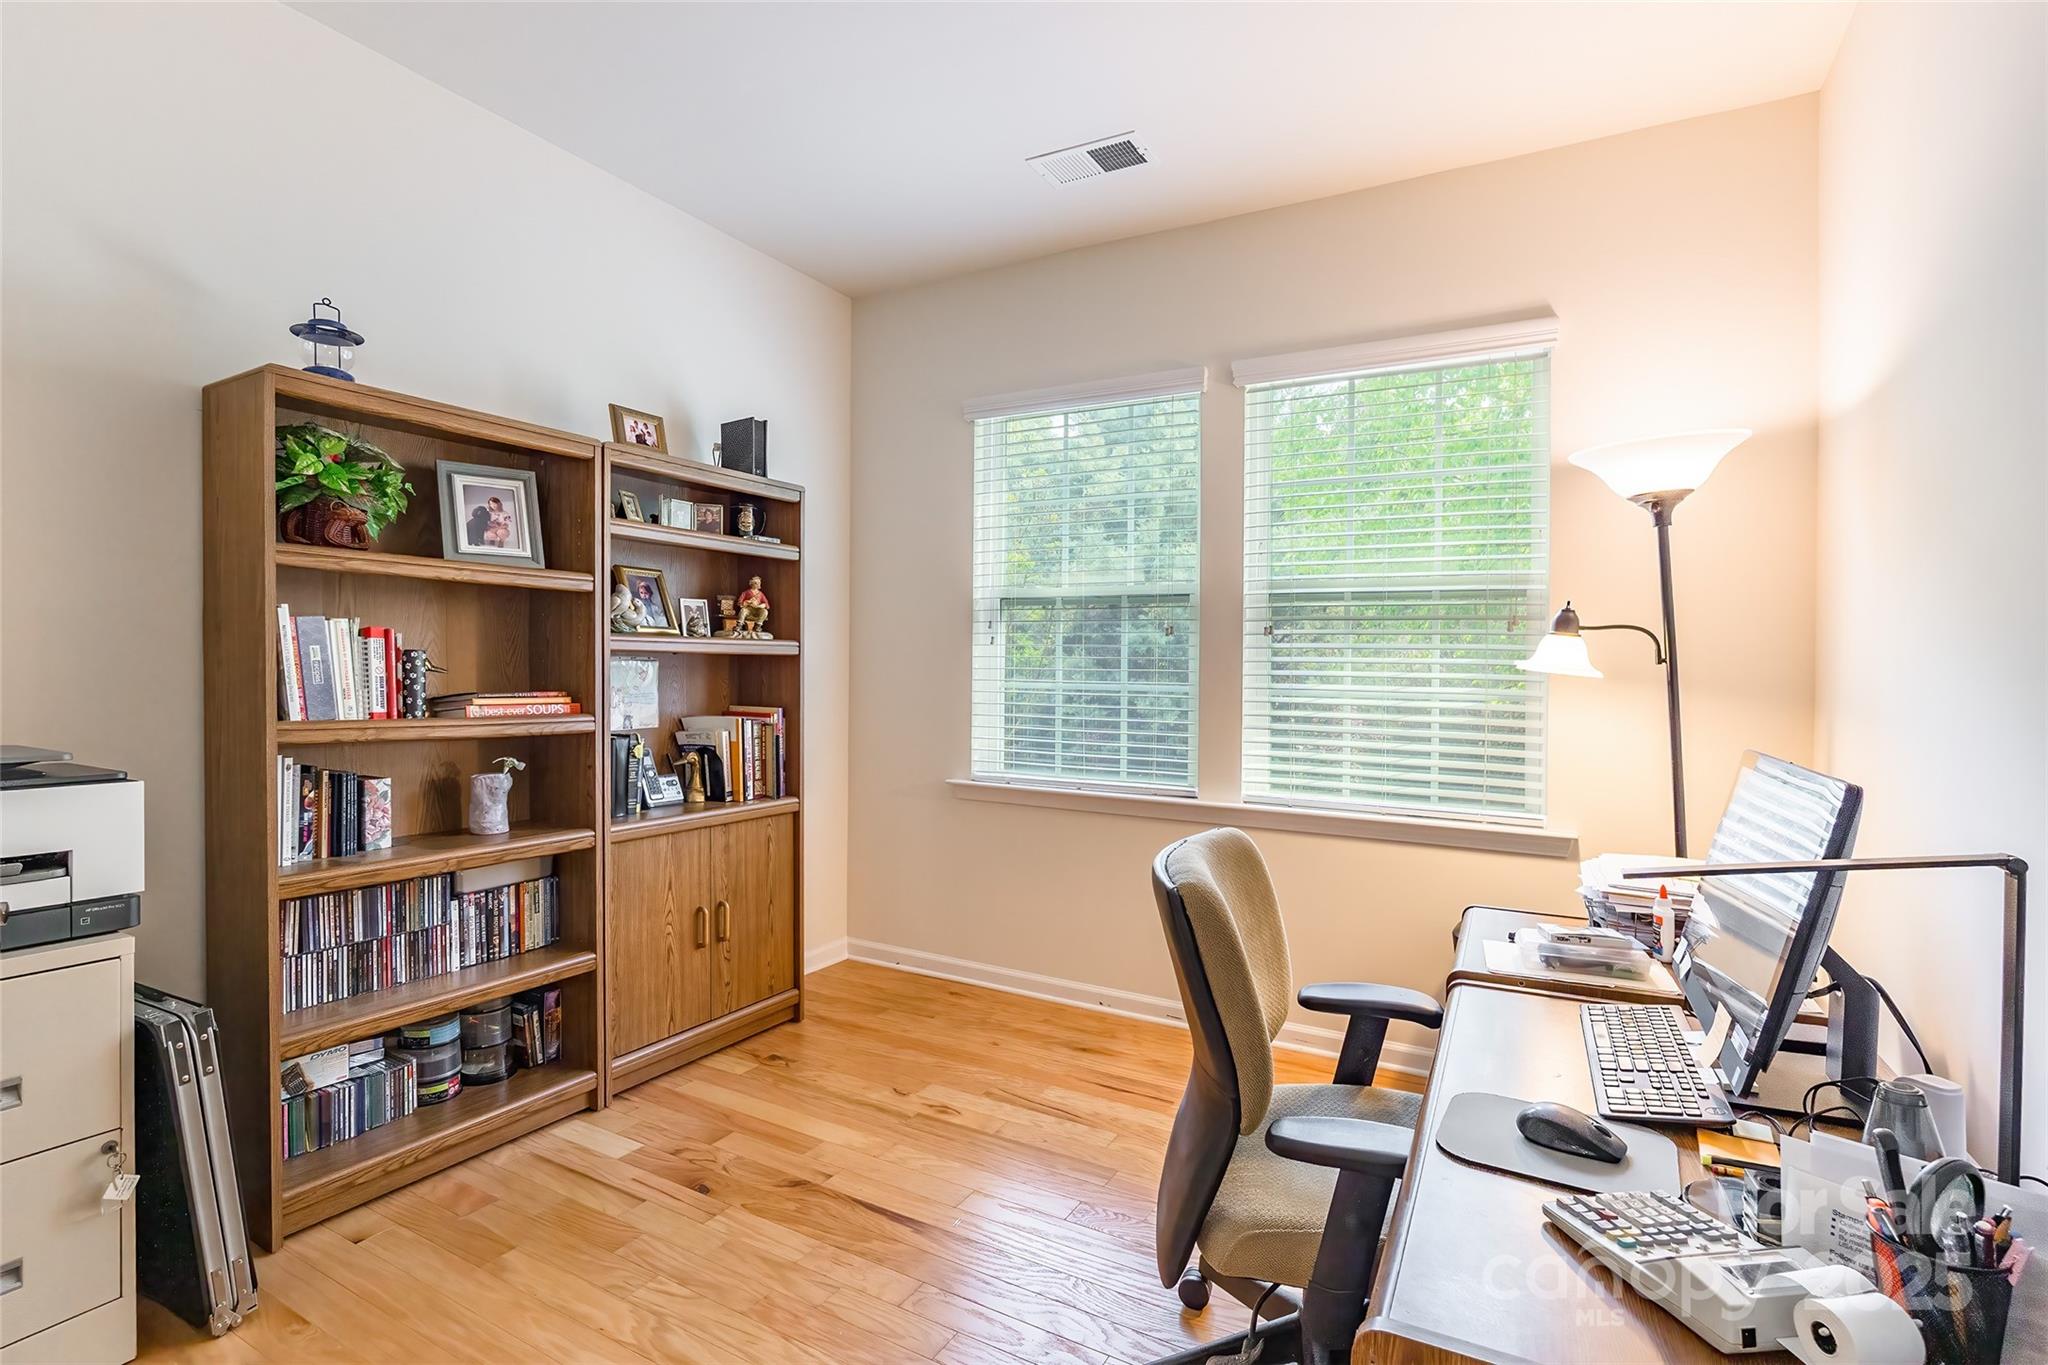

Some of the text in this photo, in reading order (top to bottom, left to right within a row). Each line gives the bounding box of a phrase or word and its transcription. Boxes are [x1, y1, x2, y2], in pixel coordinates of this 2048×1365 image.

[484, 703, 564, 717] best-ever SOUPS
[310, 1045, 347, 1061] DYMO
